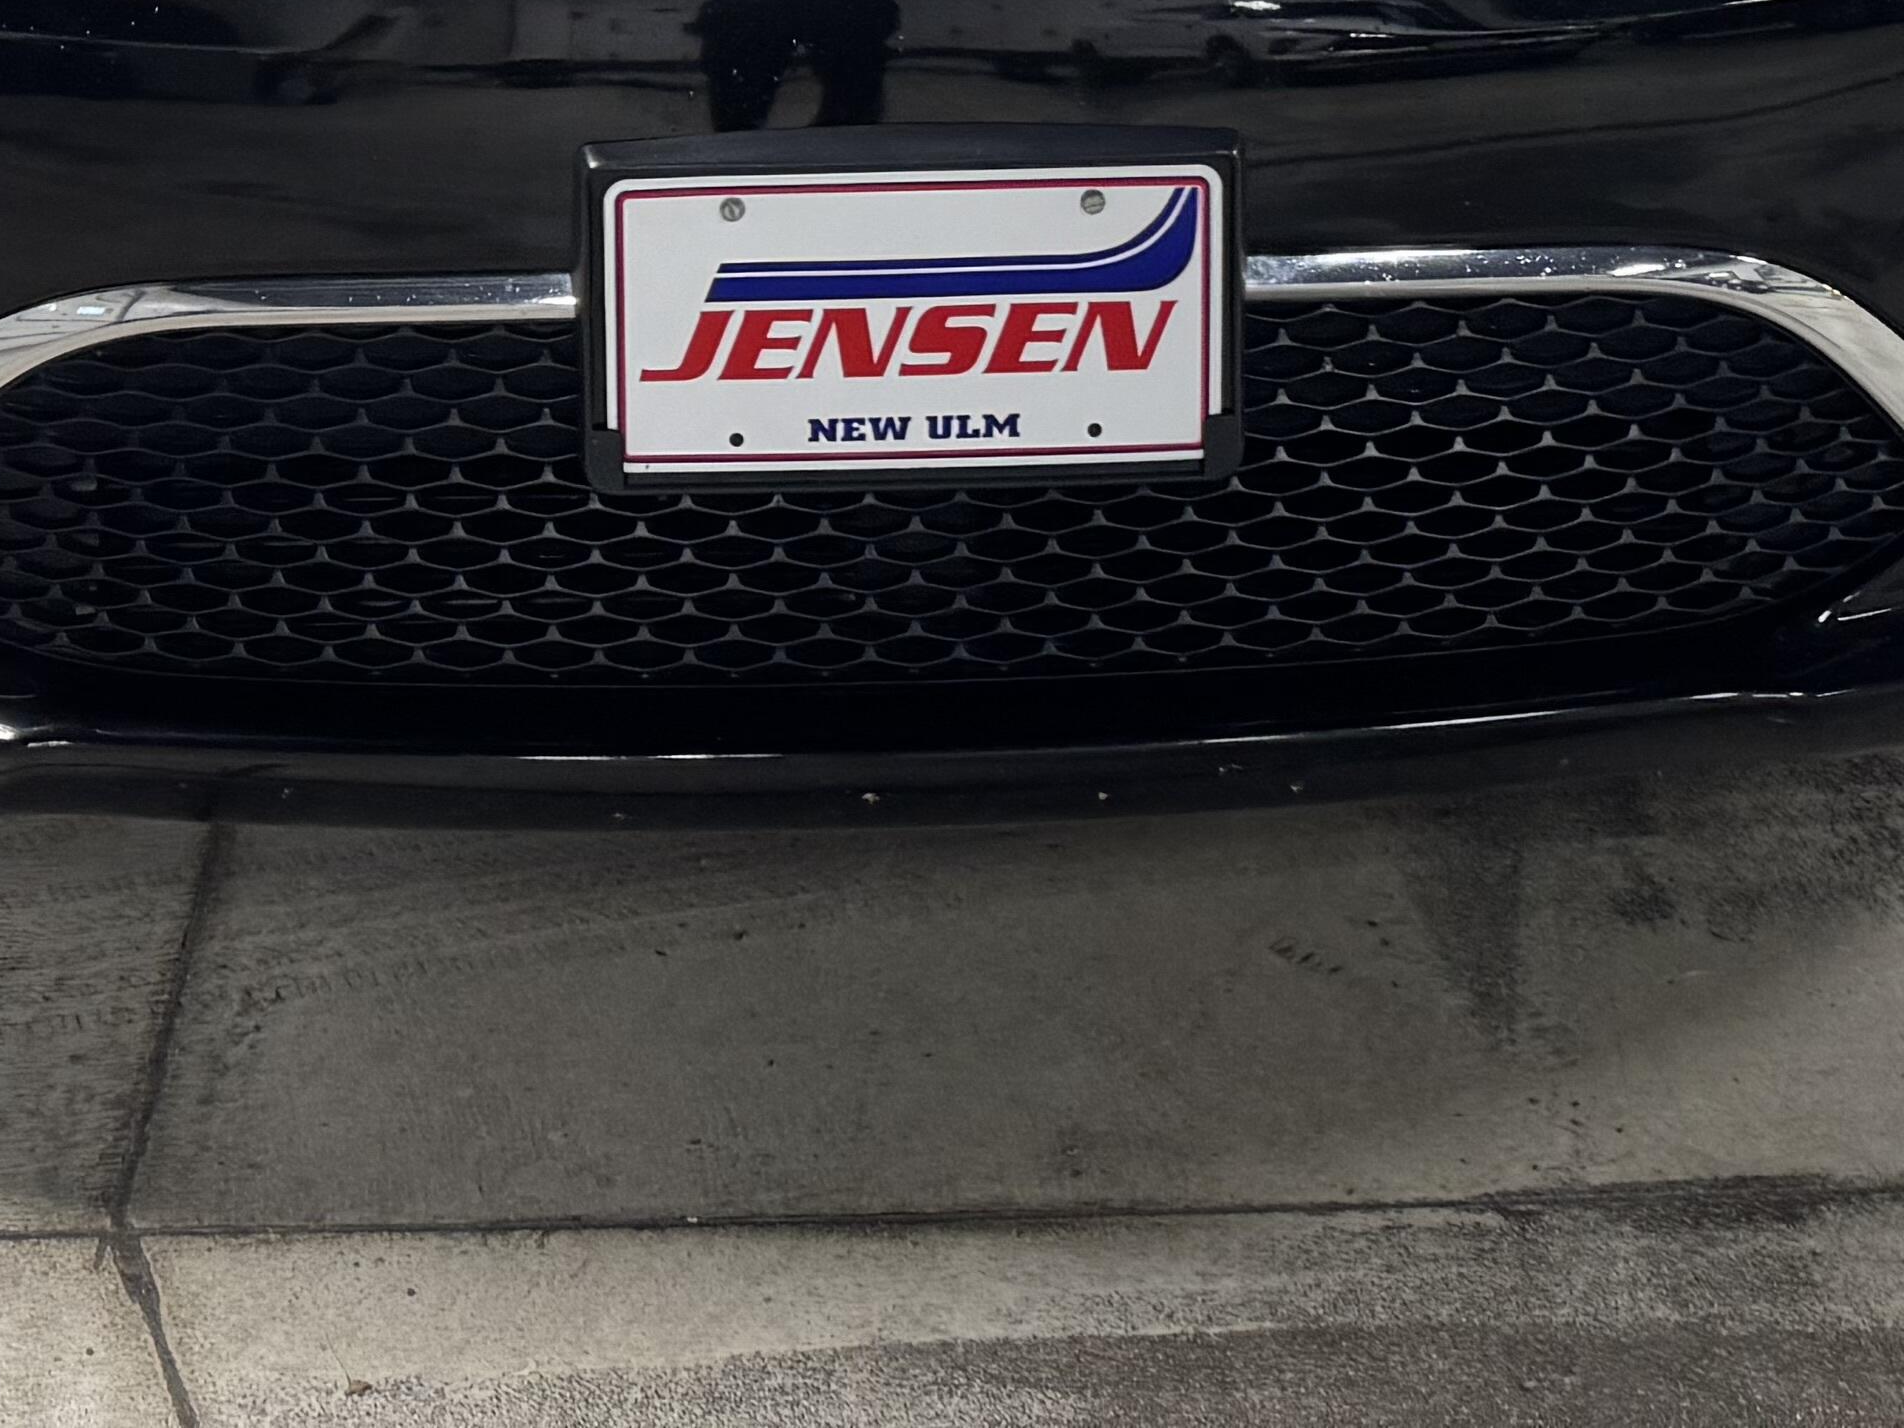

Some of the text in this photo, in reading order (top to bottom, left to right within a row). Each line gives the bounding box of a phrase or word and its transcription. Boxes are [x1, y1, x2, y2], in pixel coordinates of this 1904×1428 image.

[639, 300, 1178, 382] JENSEN
[808, 413, 1021, 443] NEW ULM
